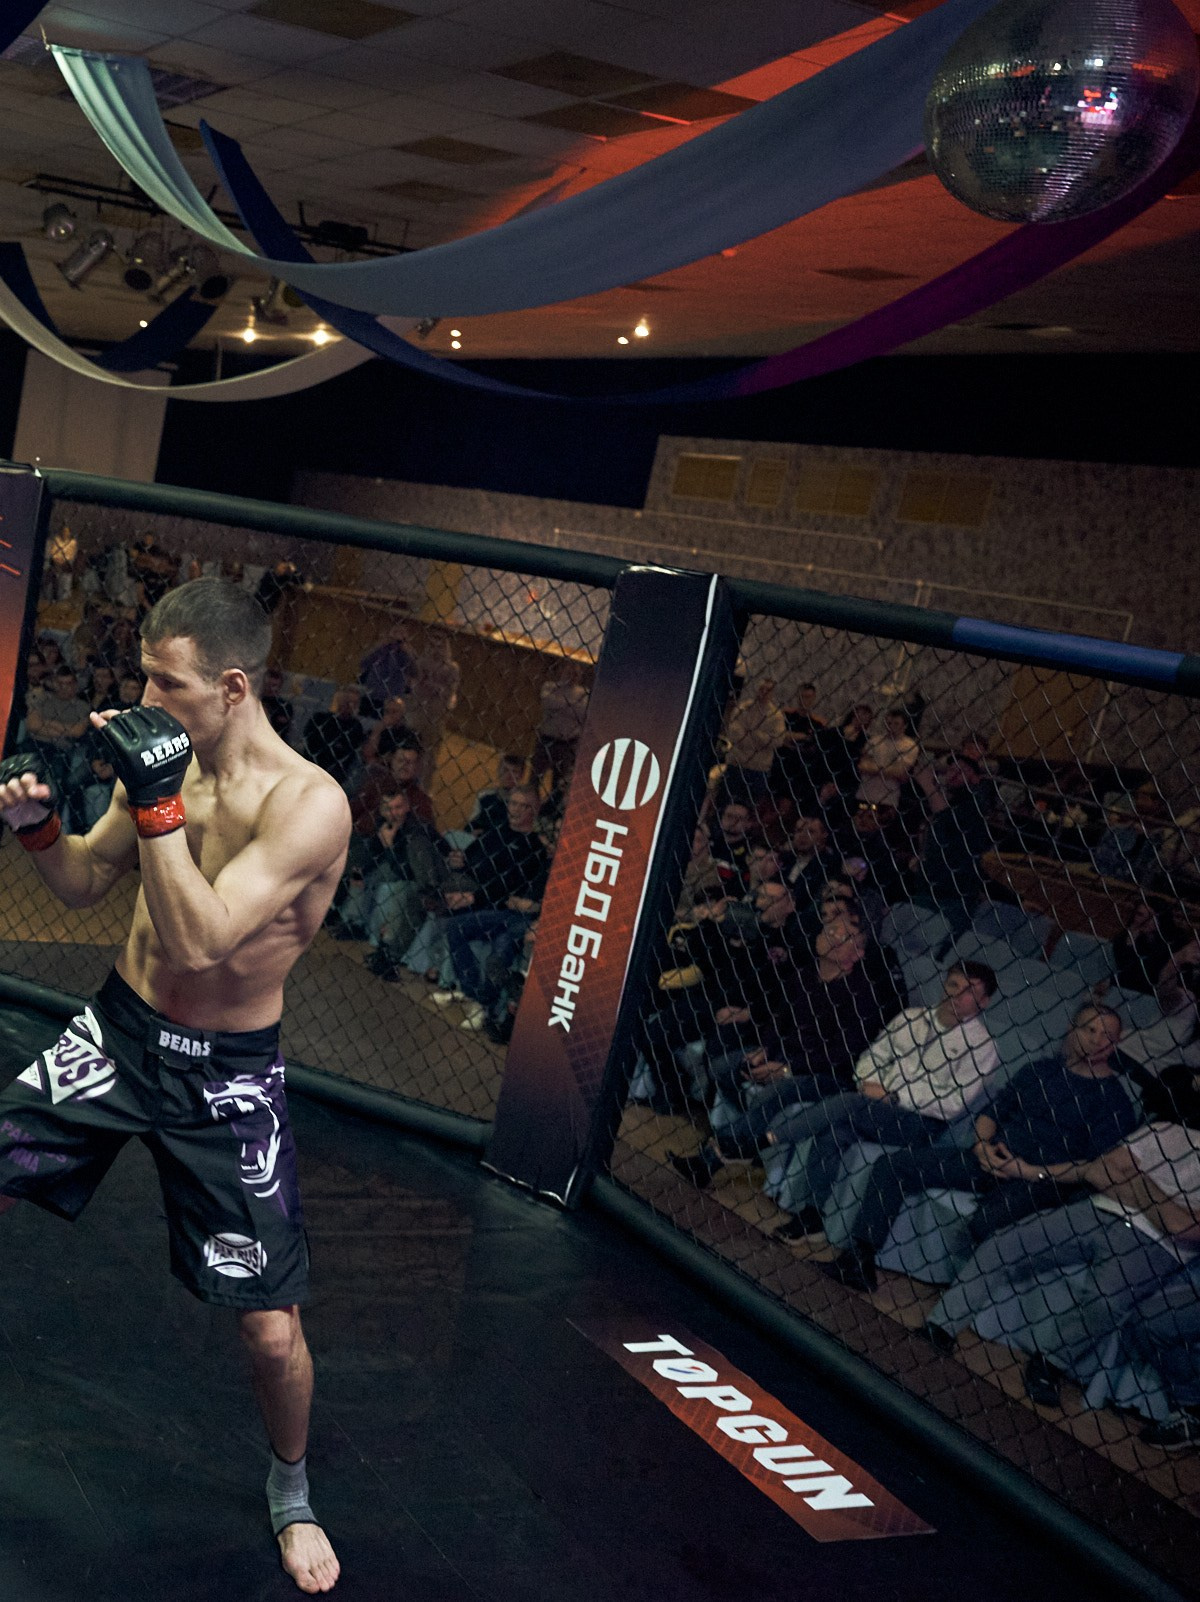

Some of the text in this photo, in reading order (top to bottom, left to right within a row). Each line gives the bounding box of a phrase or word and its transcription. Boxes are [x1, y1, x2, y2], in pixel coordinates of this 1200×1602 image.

[140, 732, 190, 767] BEARS
[548, 819, 628, 1033] НБД Банк
[158, 1030, 211, 1057] BEARS
[622, 1334, 875, 1511] TOPGUN
